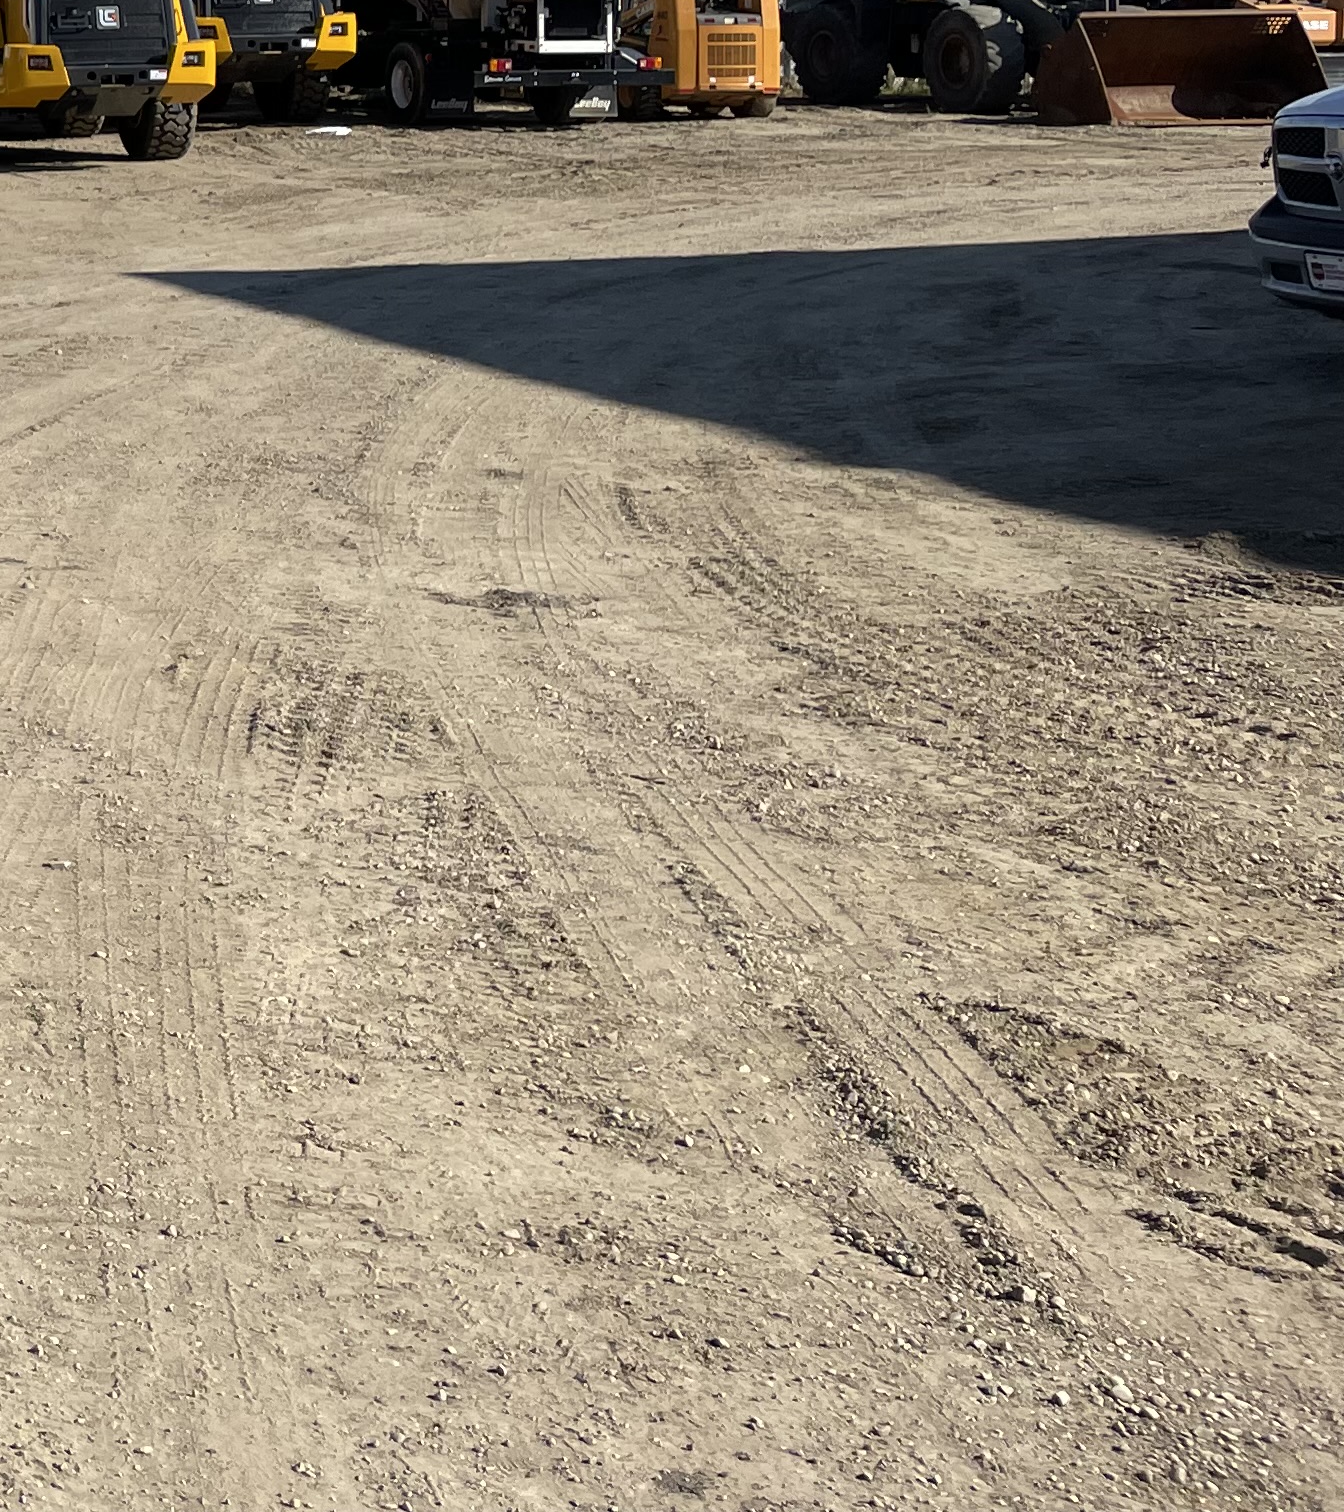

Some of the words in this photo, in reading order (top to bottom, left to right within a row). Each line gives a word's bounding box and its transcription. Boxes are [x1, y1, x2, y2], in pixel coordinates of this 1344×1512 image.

[1302, 20, 1329, 31] ASE
[431, 97, 469, 113] LeeBoy
[574, 96, 612, 112] LeeBoy
